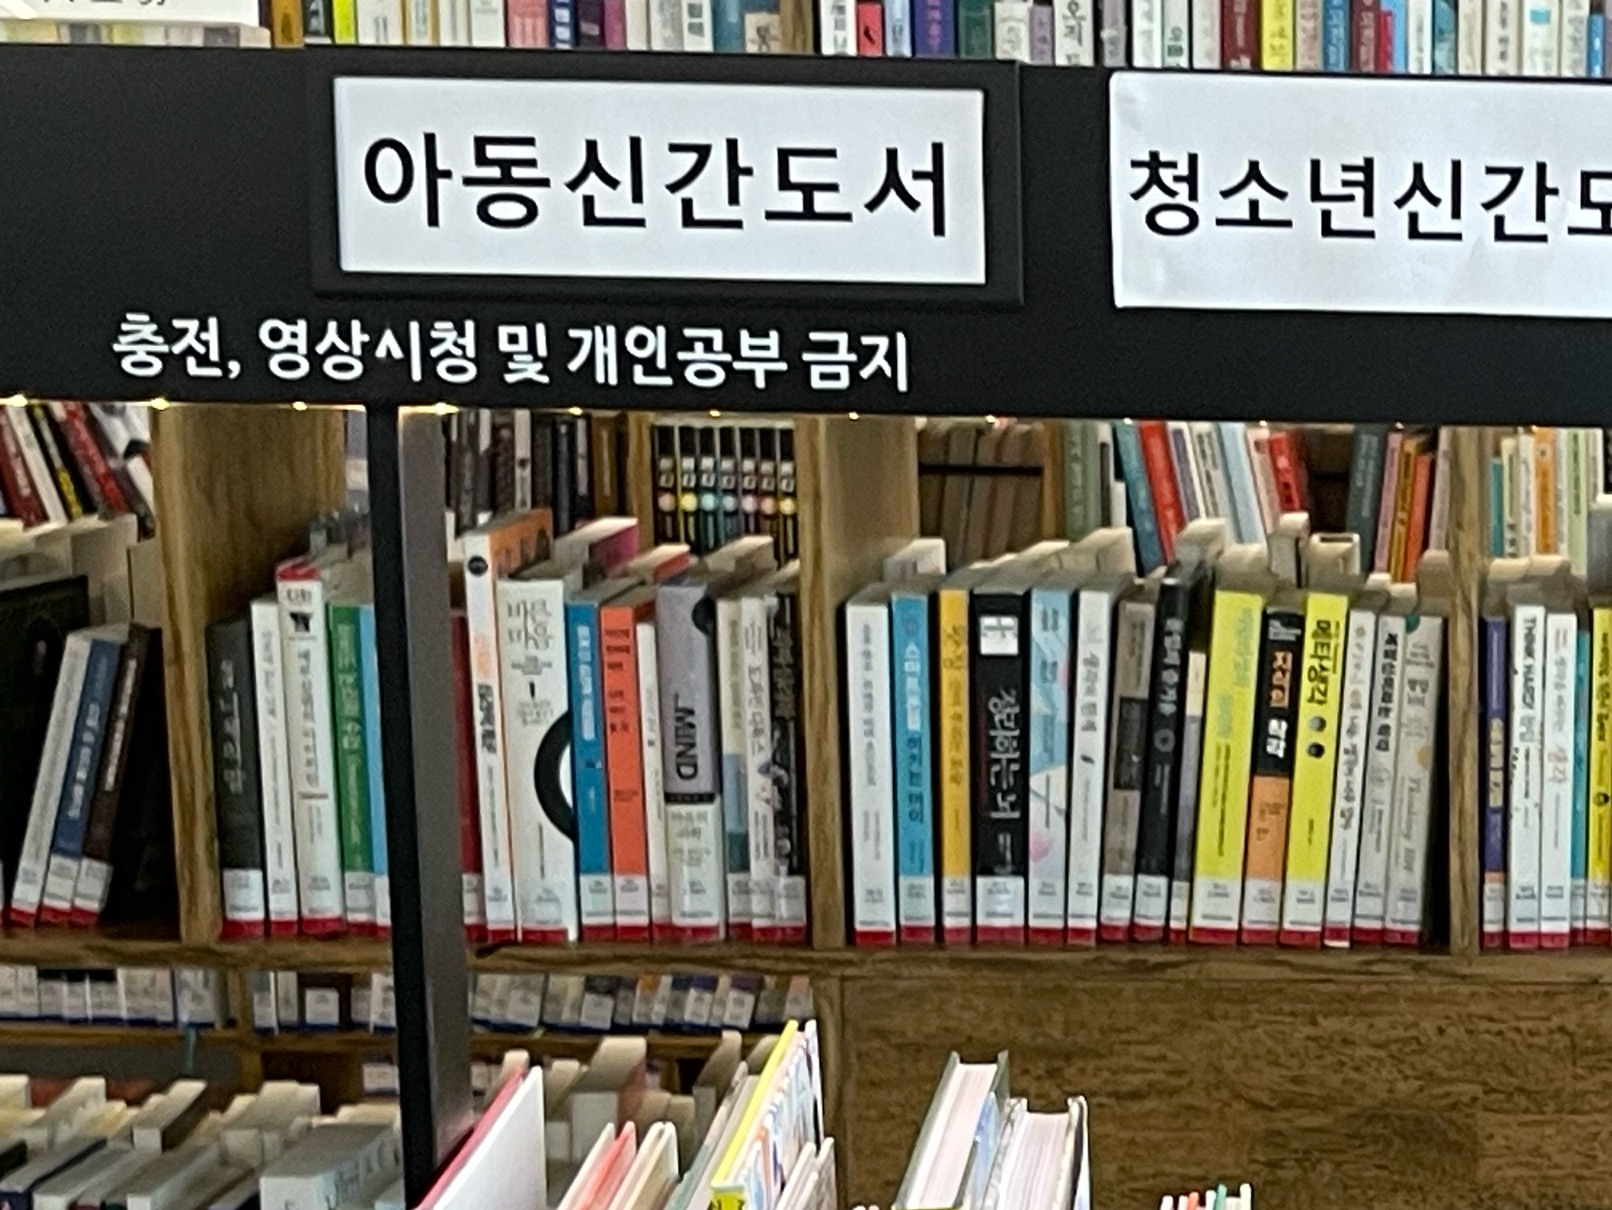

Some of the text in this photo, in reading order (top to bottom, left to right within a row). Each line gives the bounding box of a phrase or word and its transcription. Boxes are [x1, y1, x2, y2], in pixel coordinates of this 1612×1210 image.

[364, 133, 948, 237] 아동신간도서
[112, 312, 910, 393] 충전, 영상시청 및 개인공부 금지
